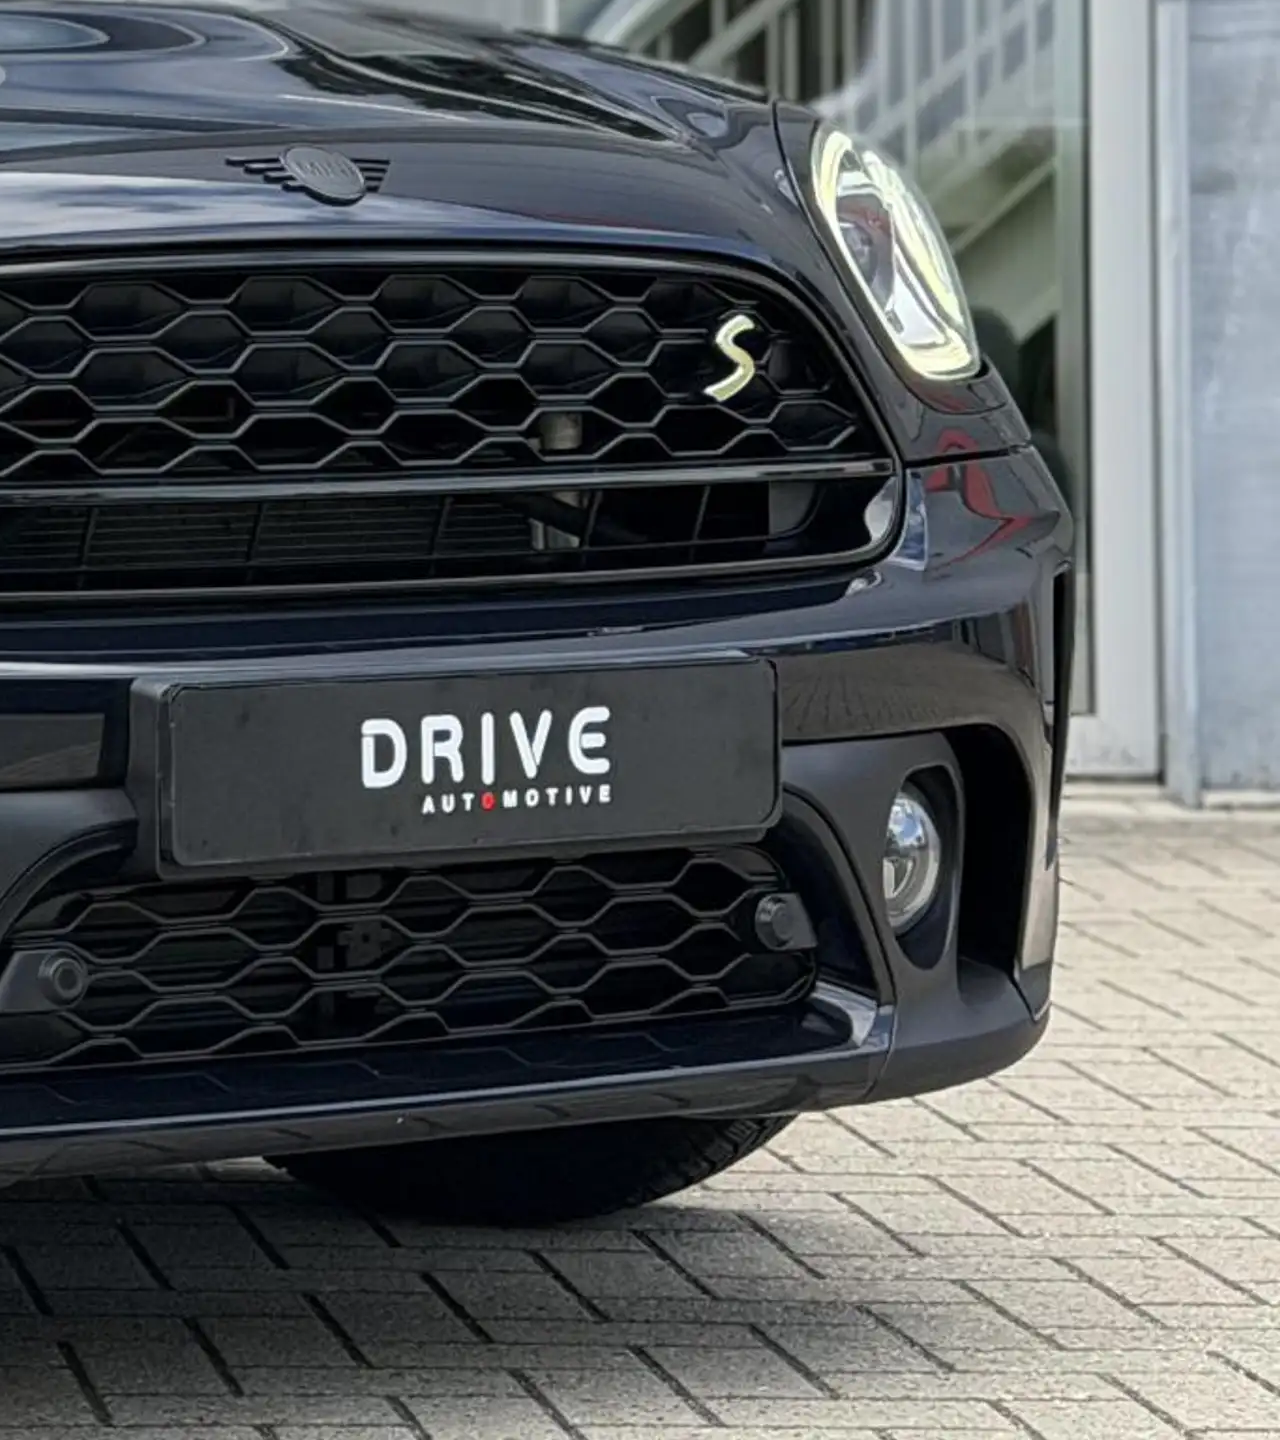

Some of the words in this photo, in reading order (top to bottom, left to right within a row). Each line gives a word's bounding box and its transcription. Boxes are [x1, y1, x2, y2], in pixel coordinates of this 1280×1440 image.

[704, 315, 755, 402] S
[361, 706, 610, 788] DRIVE
[422, 785, 611, 814] AUTOMOTIVE
